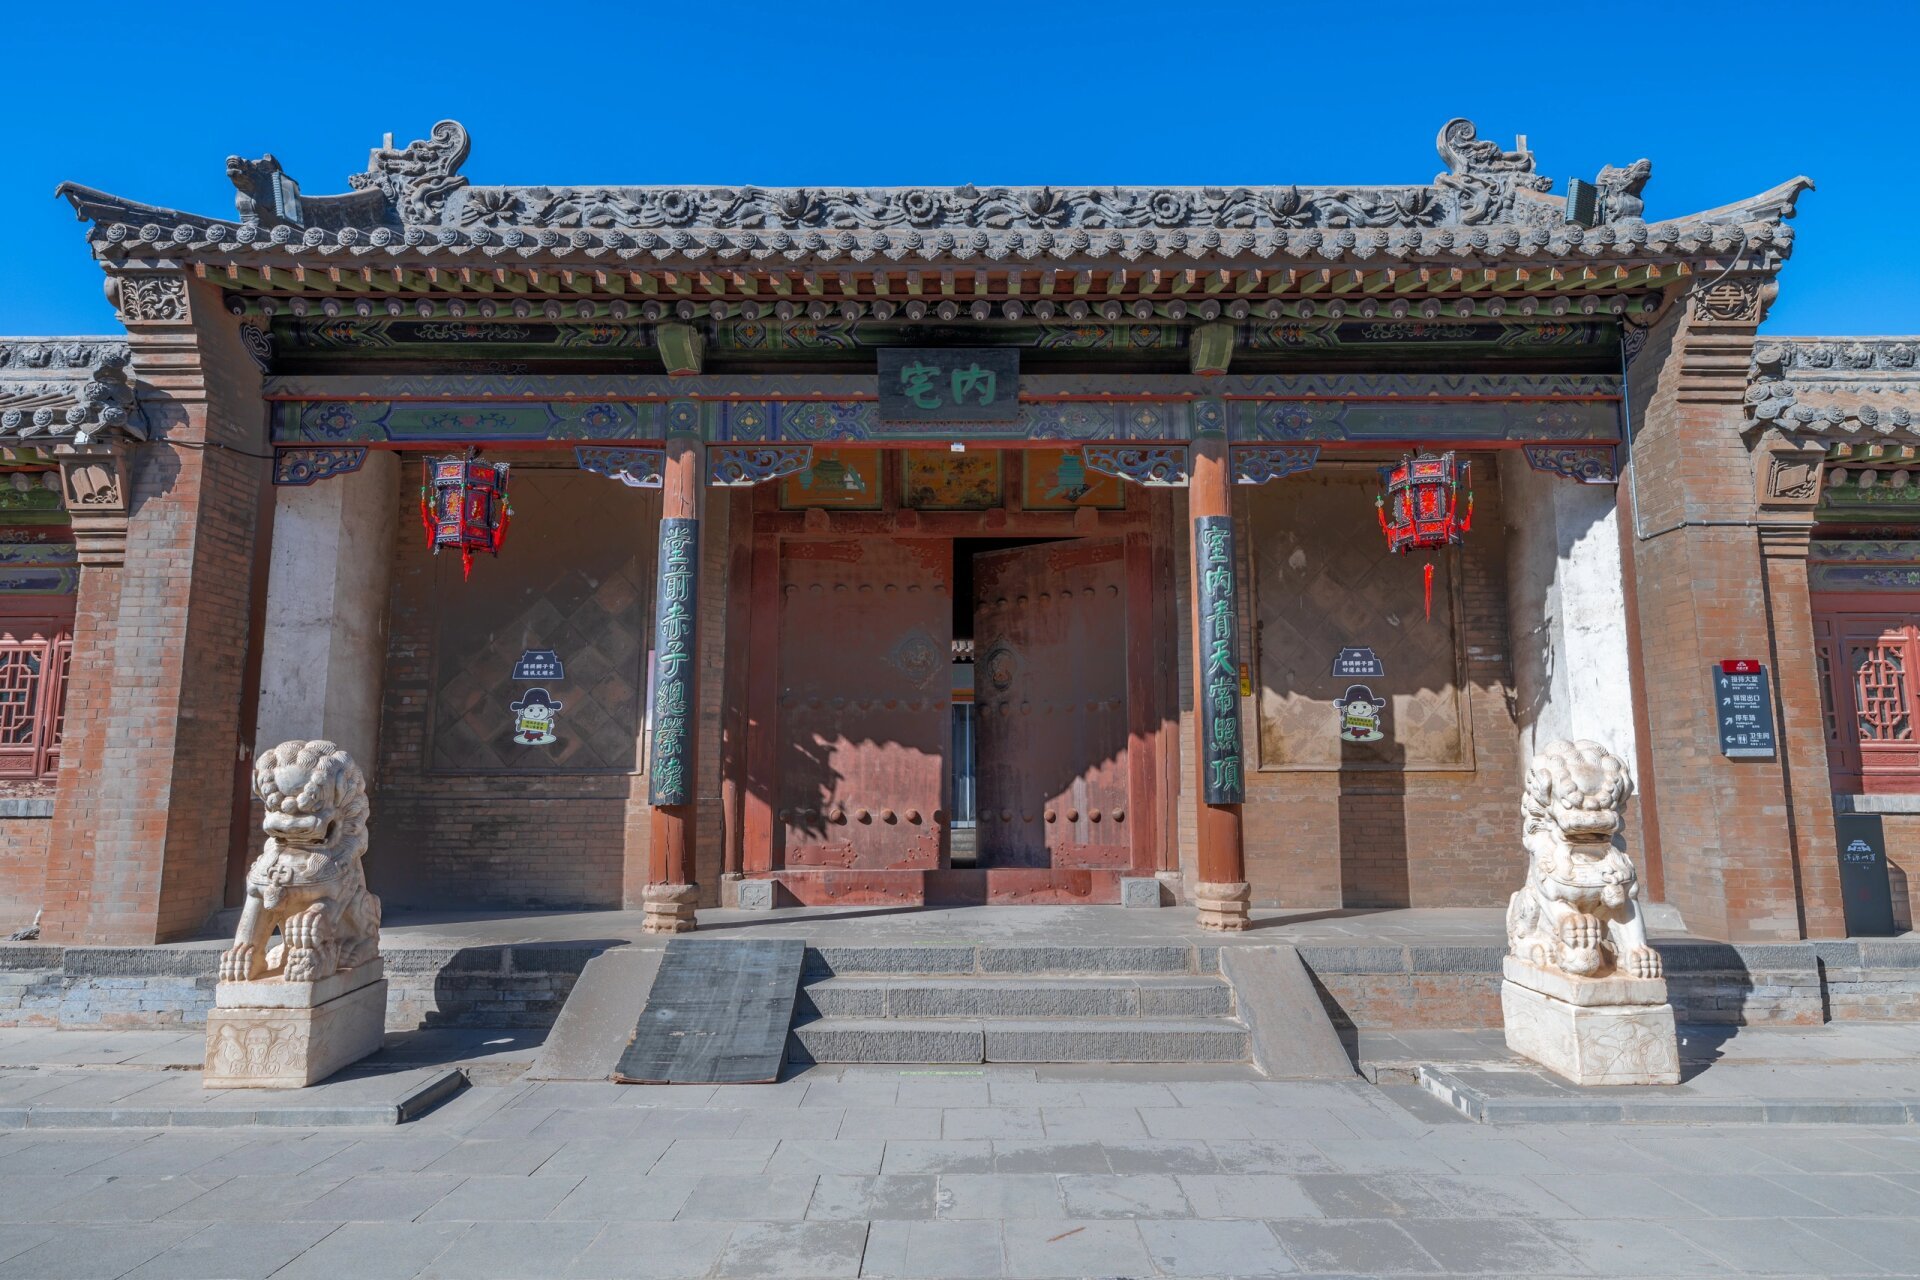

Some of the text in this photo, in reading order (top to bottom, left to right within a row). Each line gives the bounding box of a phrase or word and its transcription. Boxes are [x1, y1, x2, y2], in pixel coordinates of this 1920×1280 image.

[1731, 675, 1758, 683] 接待大堂
[1749, 732, 1770, 740] 卫生间
